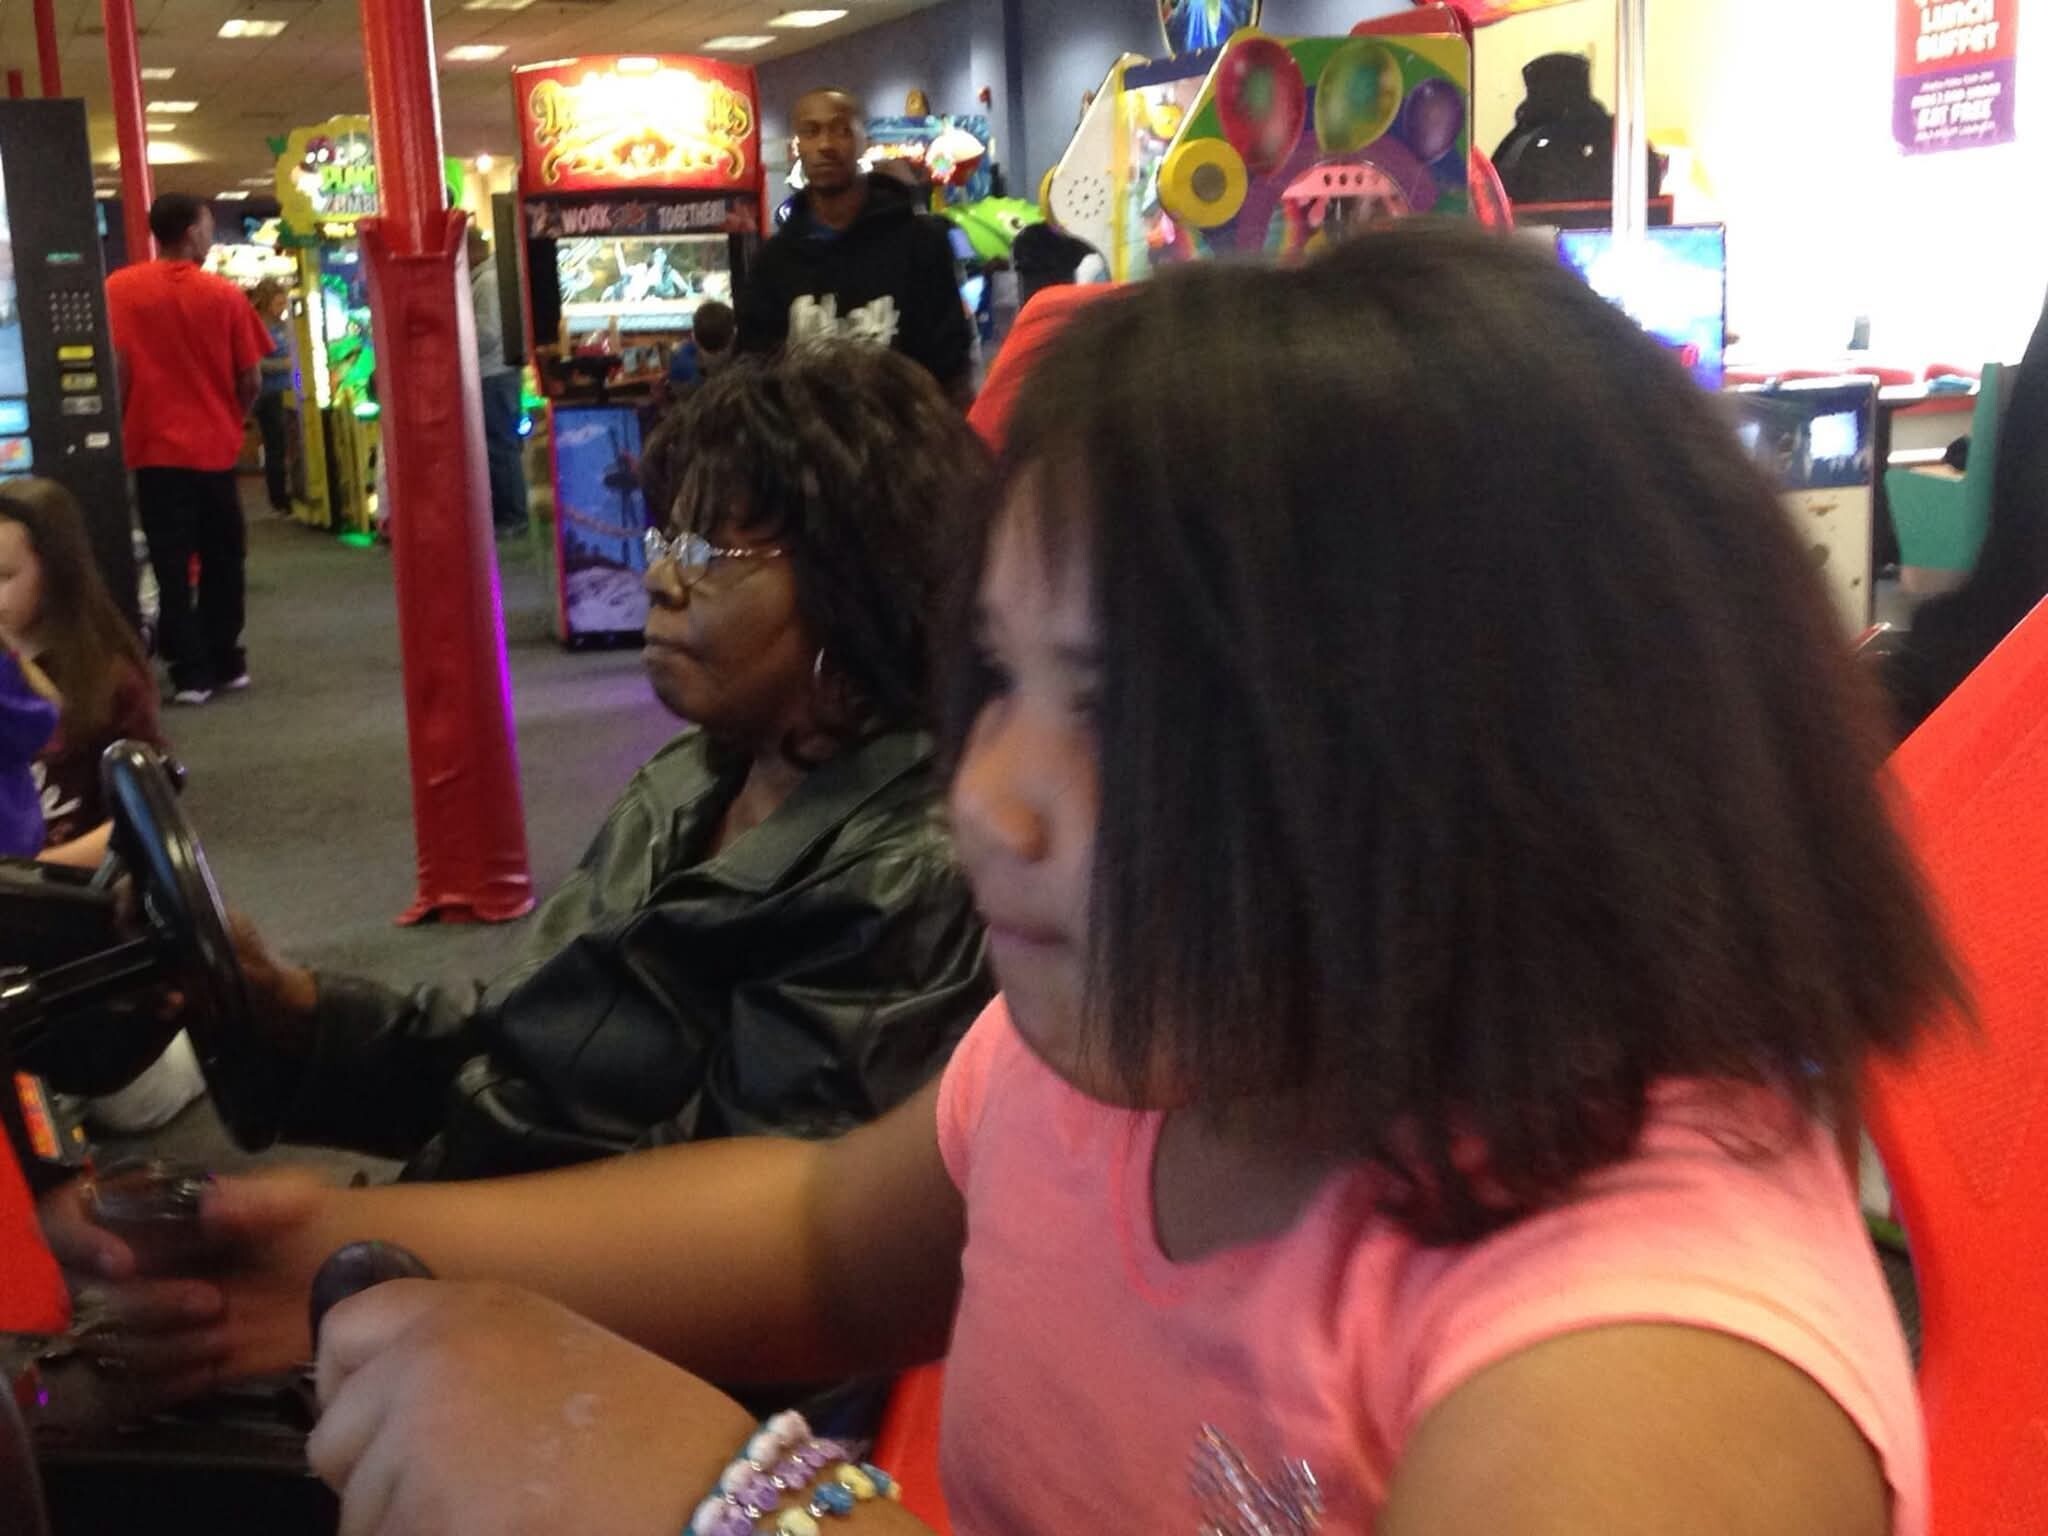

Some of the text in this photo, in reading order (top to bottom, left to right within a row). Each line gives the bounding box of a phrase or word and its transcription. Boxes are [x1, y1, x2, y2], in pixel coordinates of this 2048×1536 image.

[1921, 0, 1994, 34] LUNCH
[1916, 21, 2000, 63] BUFFET
[561, 203, 612, 232] WORK
